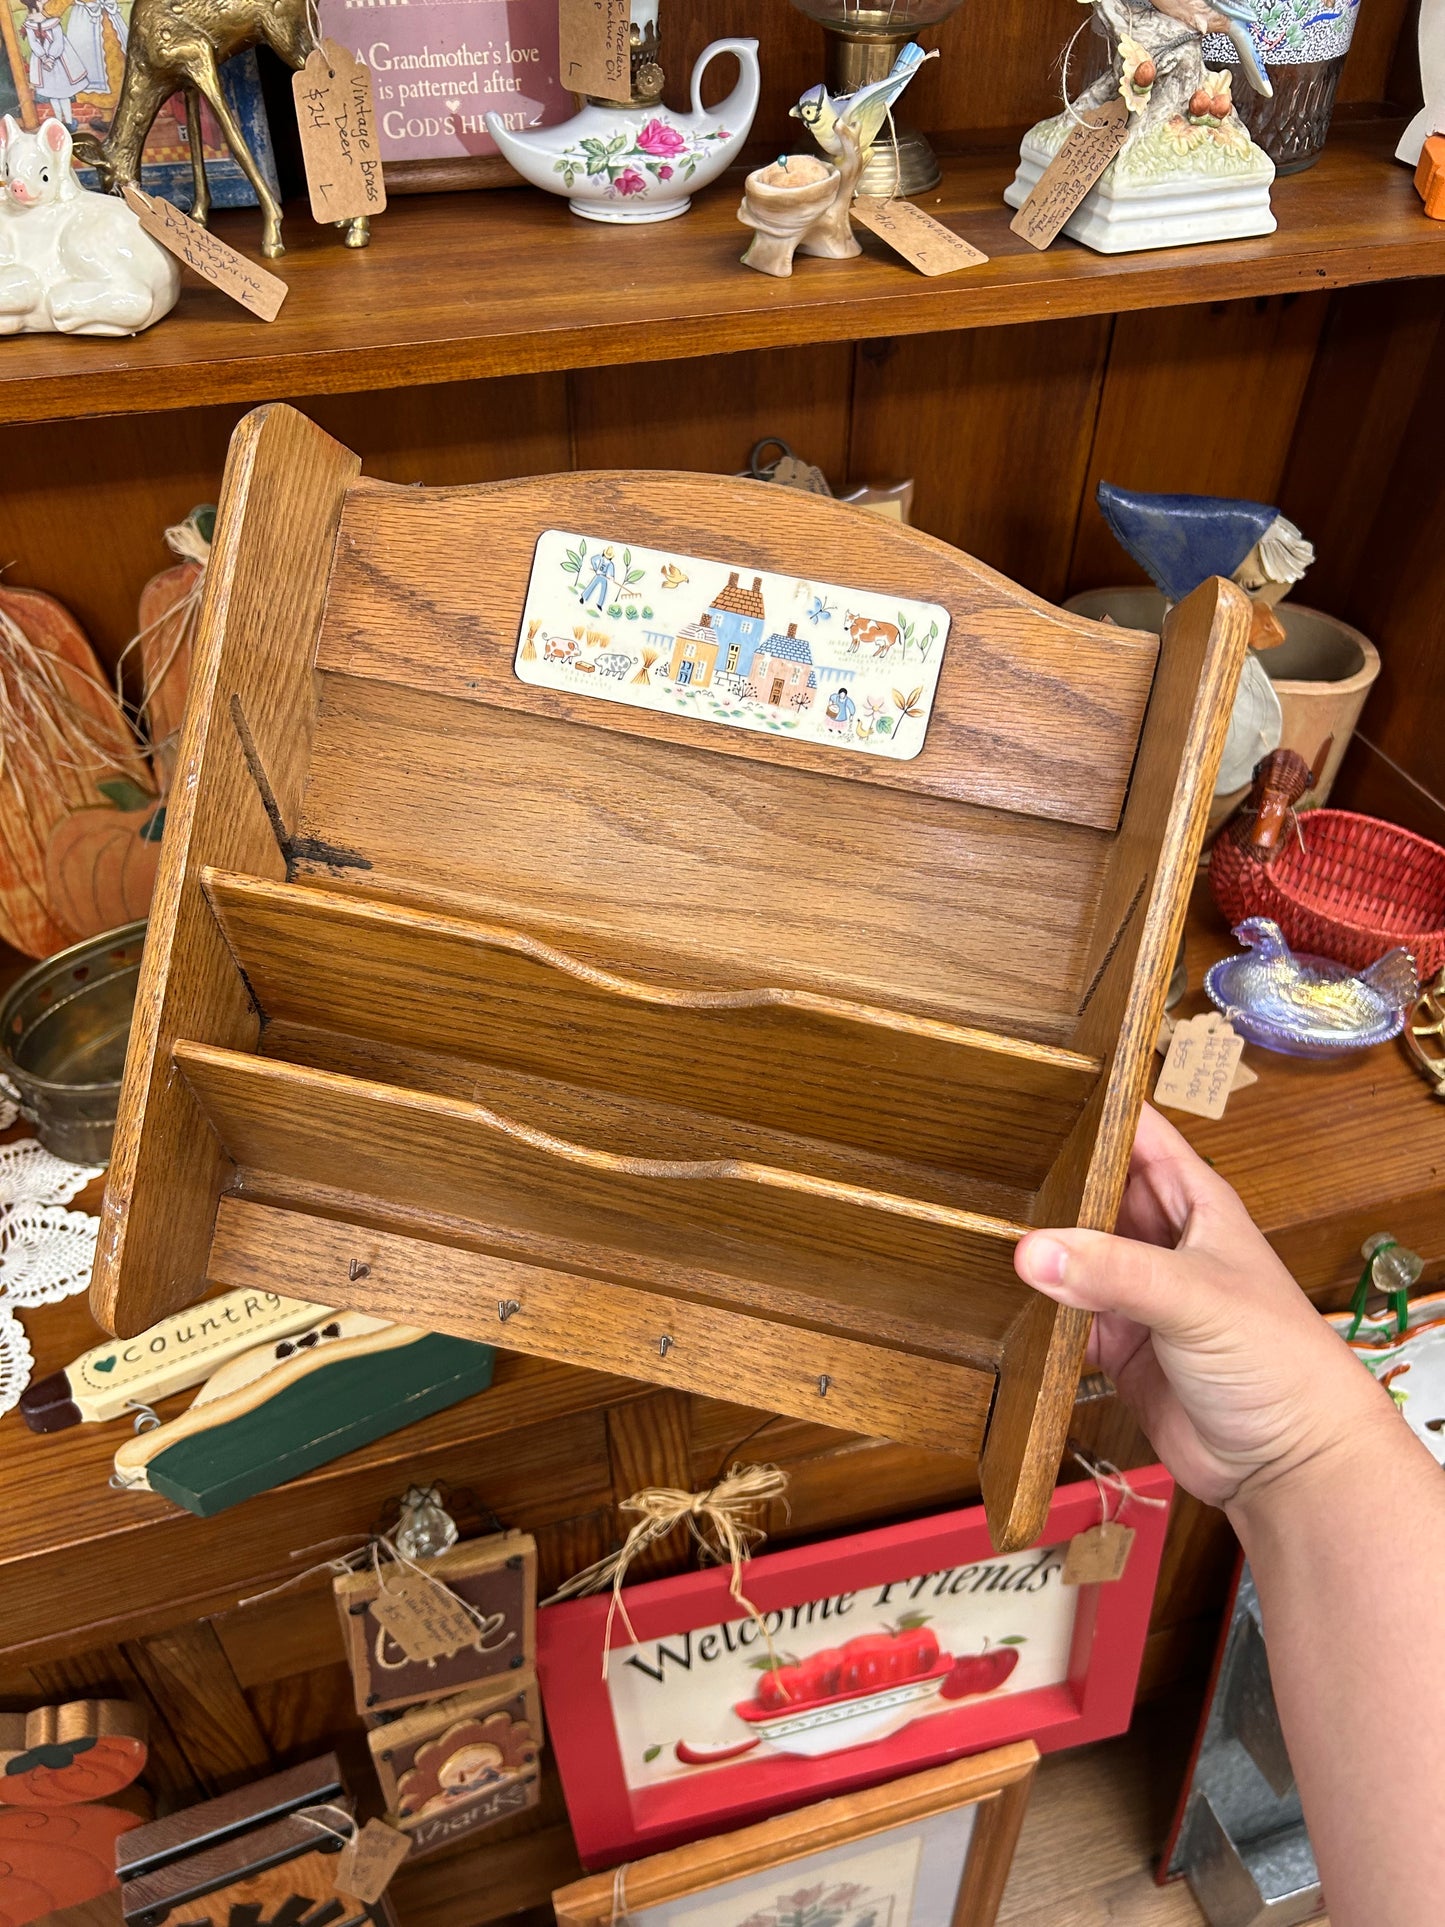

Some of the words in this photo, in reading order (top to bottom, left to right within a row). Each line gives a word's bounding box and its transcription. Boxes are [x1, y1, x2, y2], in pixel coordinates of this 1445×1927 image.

[355, 47, 367, 66] A
[369, 41, 502, 71] Grandmother's
[505, 41, 540, 63] love
[616, 20, 629, 78] Porcelain
[569, 62, 582, 76] L
[606, 60, 616, 81] Oil
[378, 79, 394, 100] is
[400, 72, 479, 107] patterned
[483, 69, 522, 93] after
[302, 88, 330, 129] $24
[350, 75, 372, 153] Vintage
[461, 111, 527, 135] HERT
[334, 103, 353, 166] Deer
[1060, 130, 1084, 160] $15
[1080, 118, 1125, 174] Porcelain
[1070, 137, 1100, 176] Music
[1086, 134, 1124, 181] Vintage
[319, 183, 333, 202] L
[360, 160, 378, 202] Brass
[1052, 182, 1070, 205] Box
[1060, 178, 1081, 205] Blue
[875, 213, 896, 230] $10
[1021, 199, 1036, 217] L
[1043, 209, 1061, 230] Jay
[164, 203, 243, 265] Vintage
[165, 217, 191, 246] Pig
[193, 240, 263, 293] Figurine
[916, 251, 927, 262] L
[183, 246, 218, 279] $10
[241, 290, 255, 303] K
